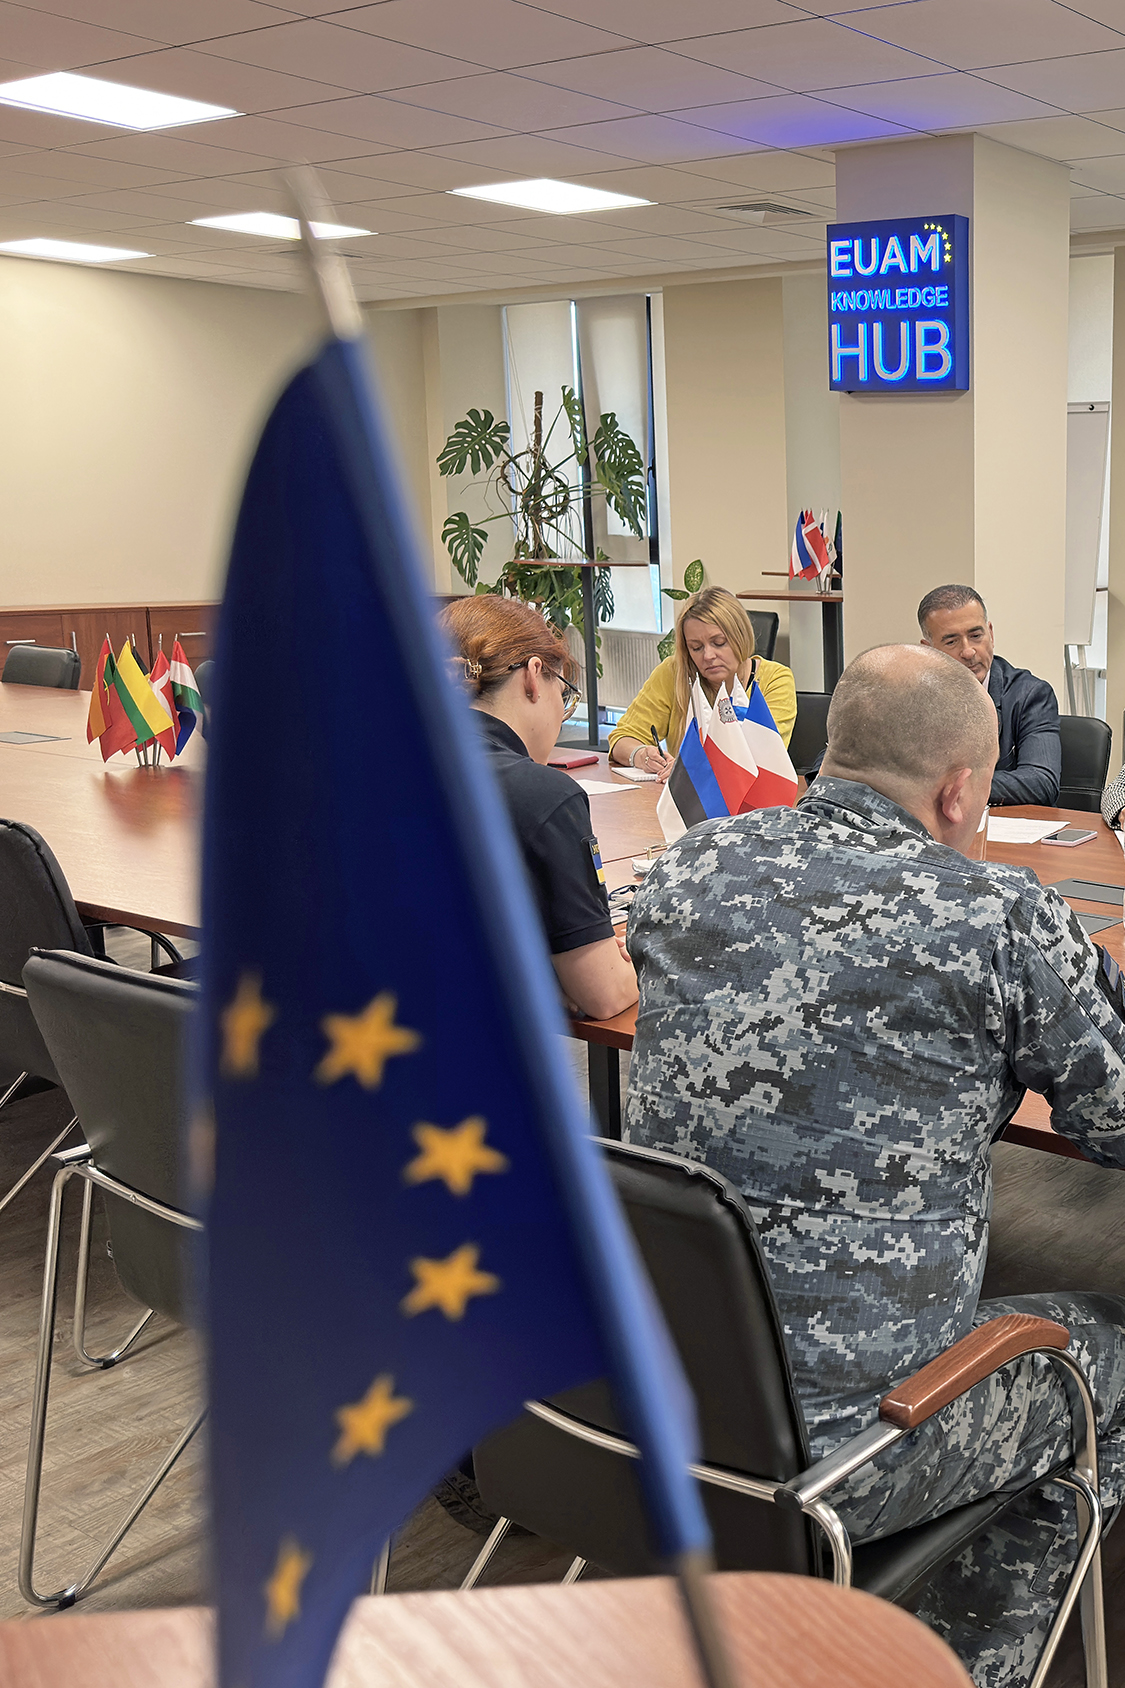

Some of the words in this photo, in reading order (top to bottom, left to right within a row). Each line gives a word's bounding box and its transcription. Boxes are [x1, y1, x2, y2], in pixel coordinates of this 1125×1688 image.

[830, 233, 940, 277] EUAM
[831, 285, 949, 311] KNOWLEDGE
[831, 319, 952, 382] HUB
